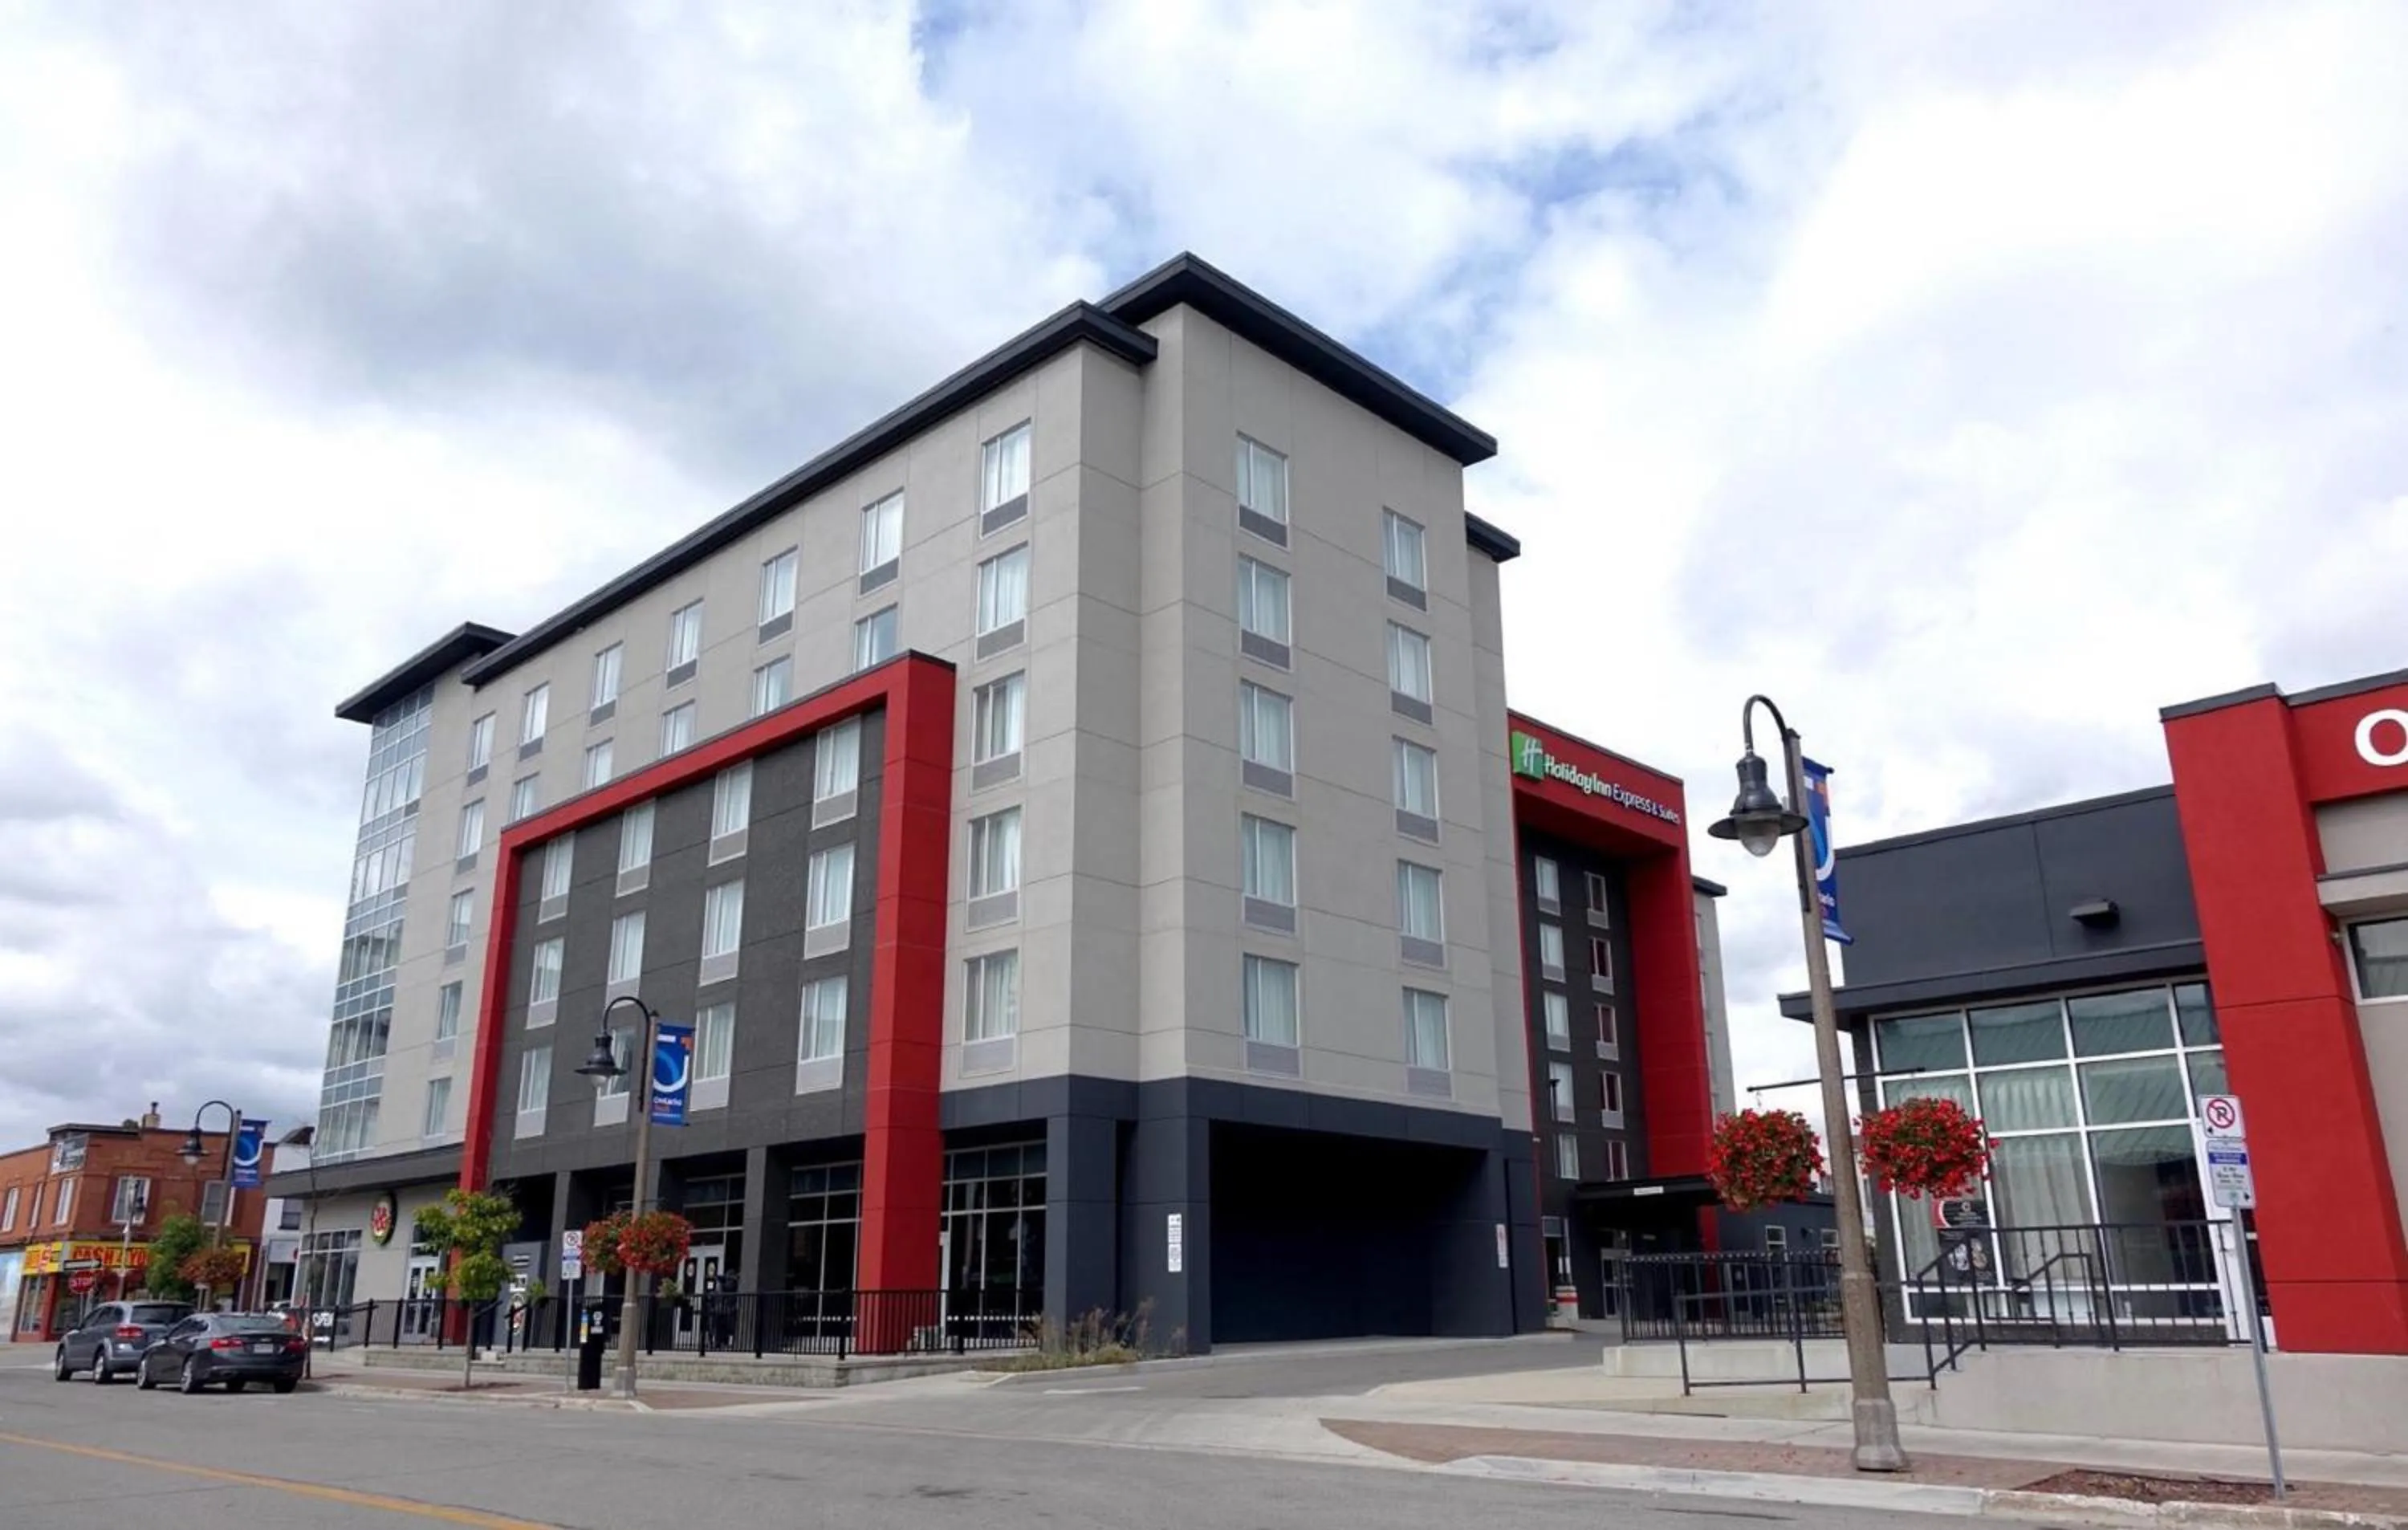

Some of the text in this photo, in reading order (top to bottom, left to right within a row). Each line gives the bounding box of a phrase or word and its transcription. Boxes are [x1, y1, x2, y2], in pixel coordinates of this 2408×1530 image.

[2354, 709, 2408, 767] O
[1613, 783, 1651, 813] Express
[1658, 804, 1681, 825] Suites
